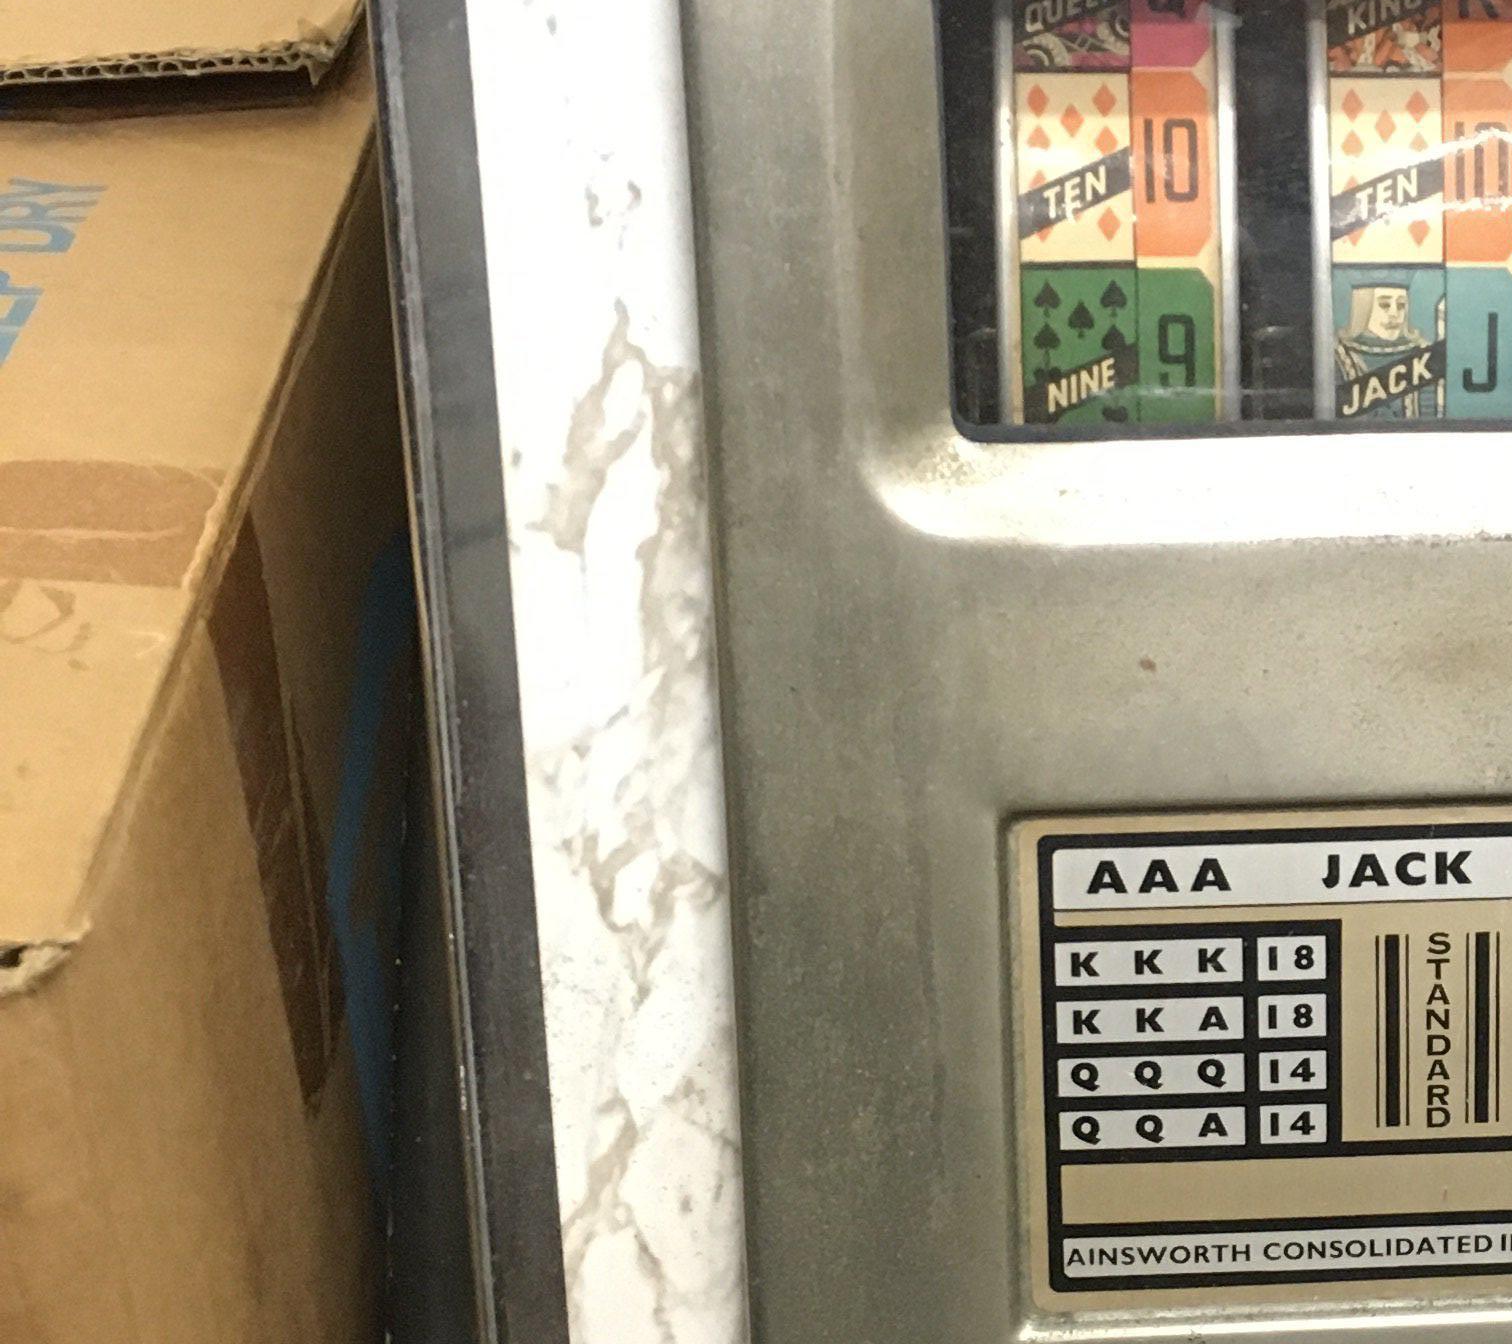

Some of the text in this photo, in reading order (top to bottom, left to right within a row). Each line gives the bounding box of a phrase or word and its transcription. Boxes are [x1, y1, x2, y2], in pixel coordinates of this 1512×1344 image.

[1043, 118, 1198, 219] TEN 10
[1355, 168, 1419, 219] TEN
[1048, 314, 1195, 413] NINE 9
[1342, 312, 1498, 416] JACK J
[1322, 851, 1471, 888] JACK
[1269, 945, 1314, 970] 18
[1268, 1004, 1313, 1029] 18
[1427, 932, 1452, 1128] STANDARD
[1270, 1058, 1315, 1083] 14
[1270, 1111, 1315, 1136] 14
[1066, 1242, 1251, 1268] AINSWORTH
[1264, 1235, 1492, 1260] CONSOLIDATED
